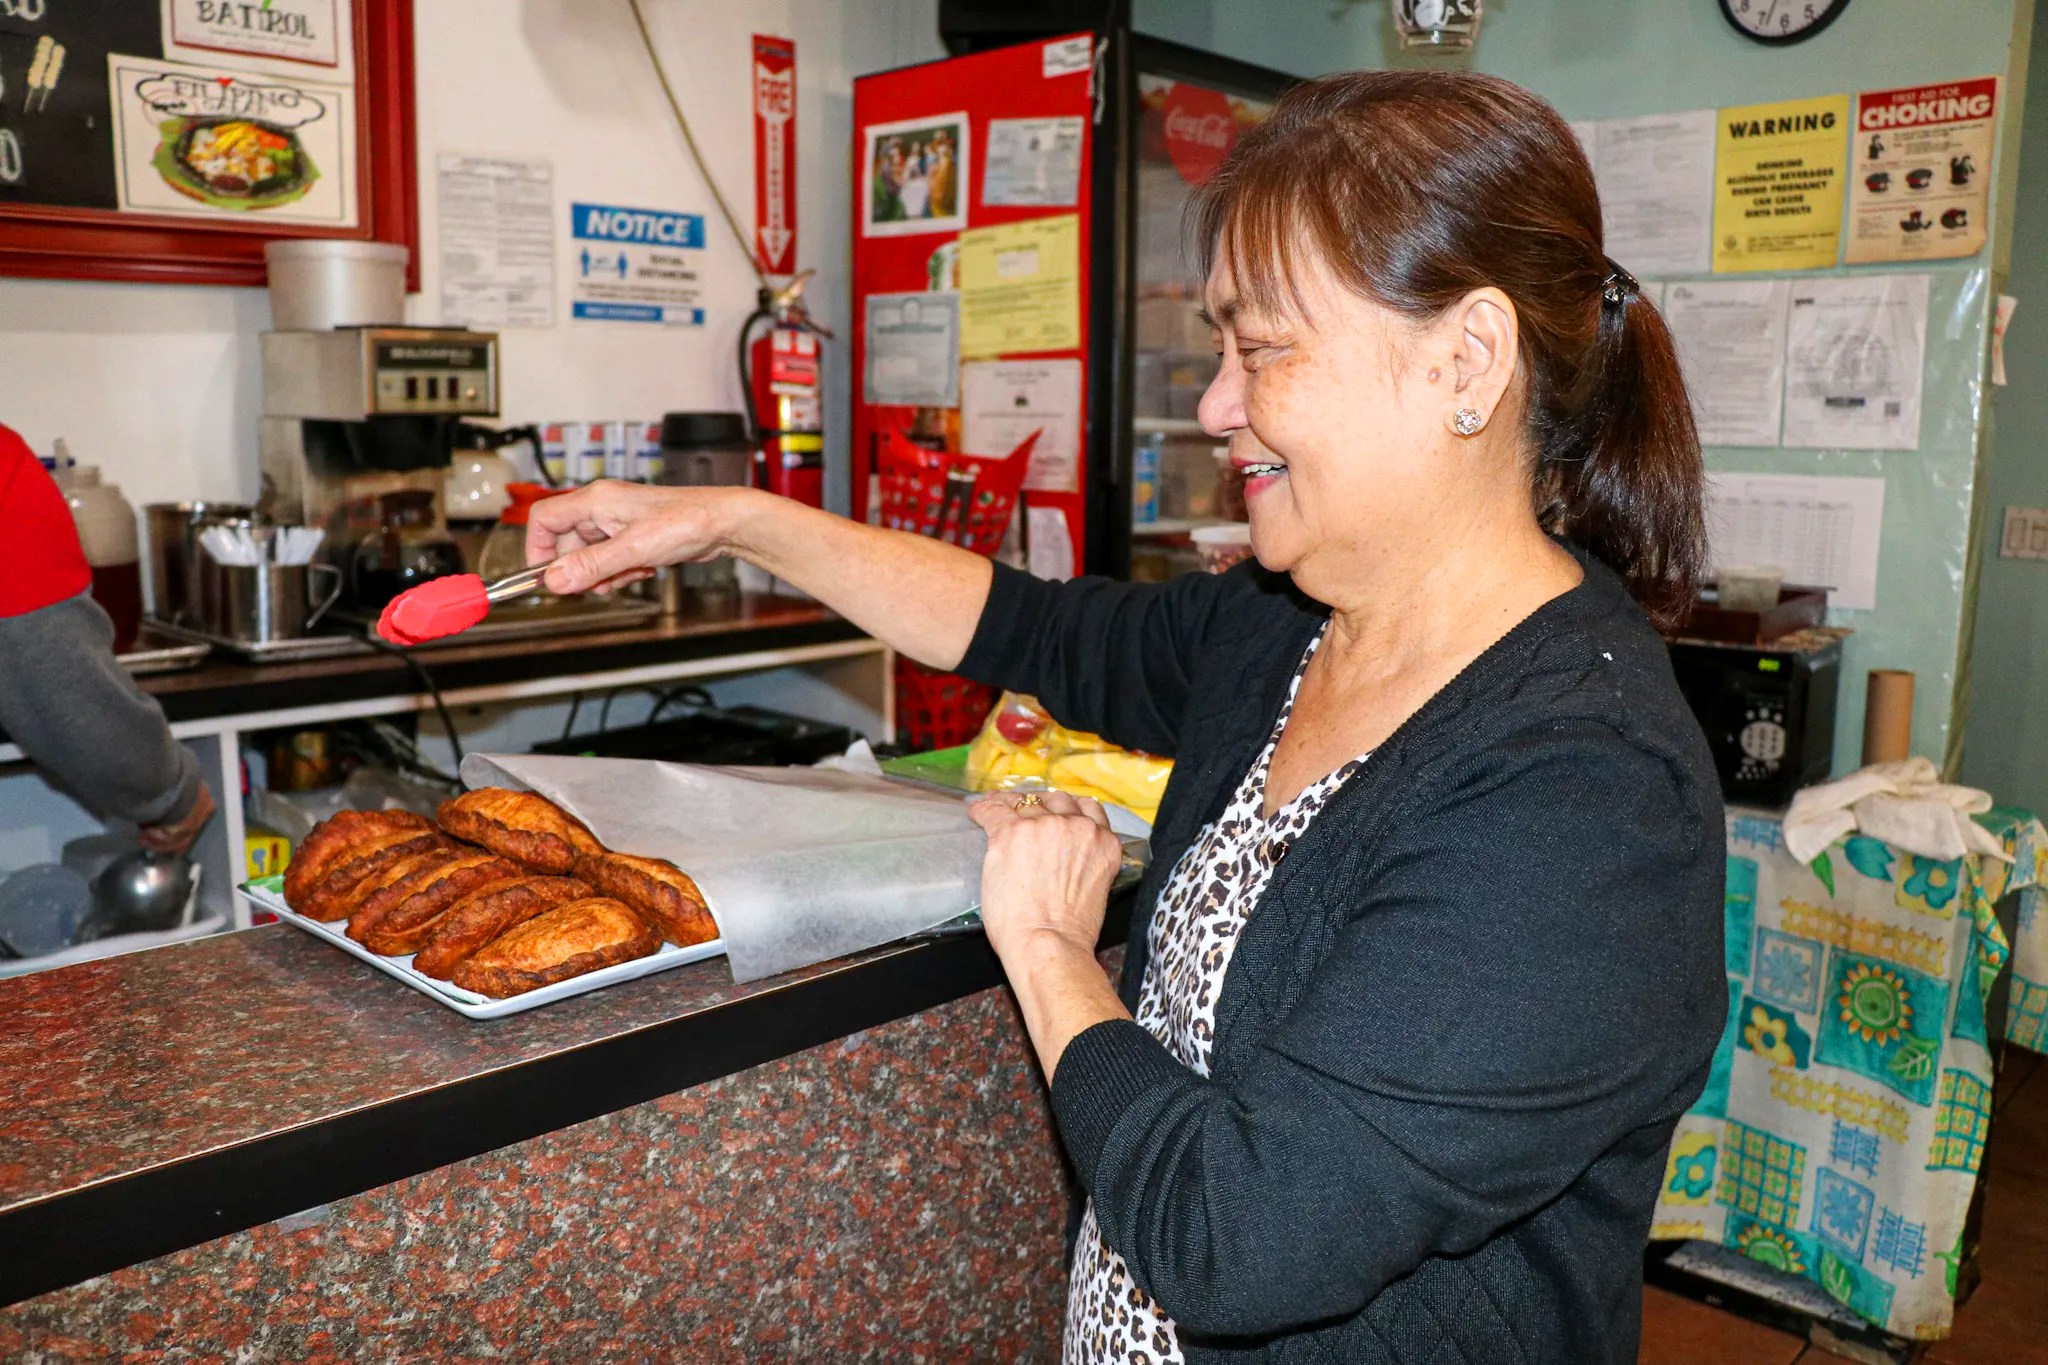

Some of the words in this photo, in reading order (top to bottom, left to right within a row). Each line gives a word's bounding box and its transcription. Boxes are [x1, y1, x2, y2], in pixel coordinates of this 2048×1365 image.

[1758, 10, 1767, 26] 7
[1780, 13, 1789, 28] 6
[1940, 86, 1960, 98] FOR
[1862, 94, 1990, 129] CHOKING
[1729, 112, 1837, 139] WARNING
[586, 209, 690, 243] NOTICE
